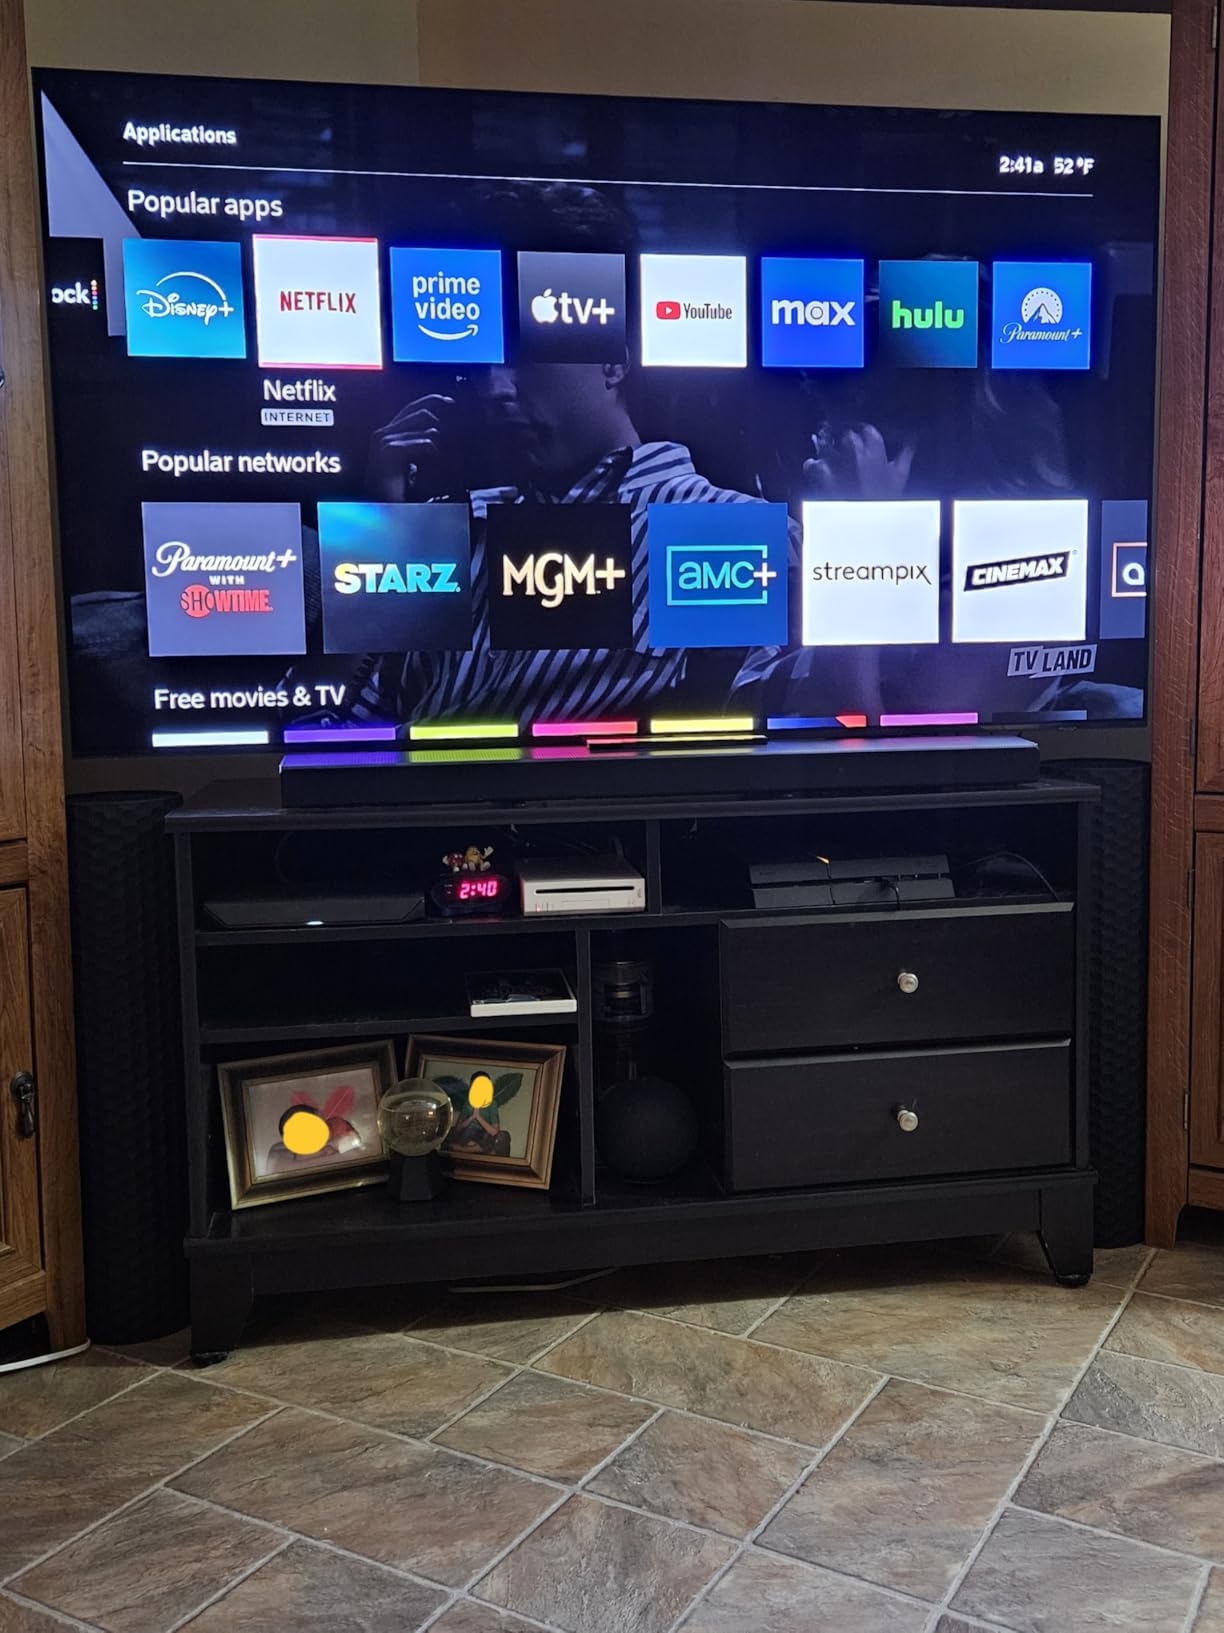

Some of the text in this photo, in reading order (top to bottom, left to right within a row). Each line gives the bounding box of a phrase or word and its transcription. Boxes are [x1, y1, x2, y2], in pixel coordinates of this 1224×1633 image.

[123, 121, 237, 146] Applications
[999, 155, 1044, 174] 2:41a
[127, 190, 283, 220] Popular apps
[412, 271, 481, 296] prime
[280, 290, 356, 314] NETFLIX
[415, 296, 480, 321] video
[559, 293, 615, 324] tv+
[683, 302, 733, 320] YouTube
[771, 299, 856, 327] max
[892, 301, 964, 329] hulu
[999, 323, 1083, 344] Paramount+
[263, 380, 336, 402] Netflix
[263, 411, 332, 424] INTERNET
[142, 450, 341, 476] Popular networks
[151, 541, 297, 577] Paramount+
[972, 556, 1064, 585] CINEMAX
[209, 575, 245, 585] WITH
[502, 553, 626, 608] MGM+
[812, 563, 932, 585] streampix
[1014, 648, 1092, 672] TV LAND
[154, 685, 346, 711] Free movies & TV
[459, 880, 498, 899] 2:40
